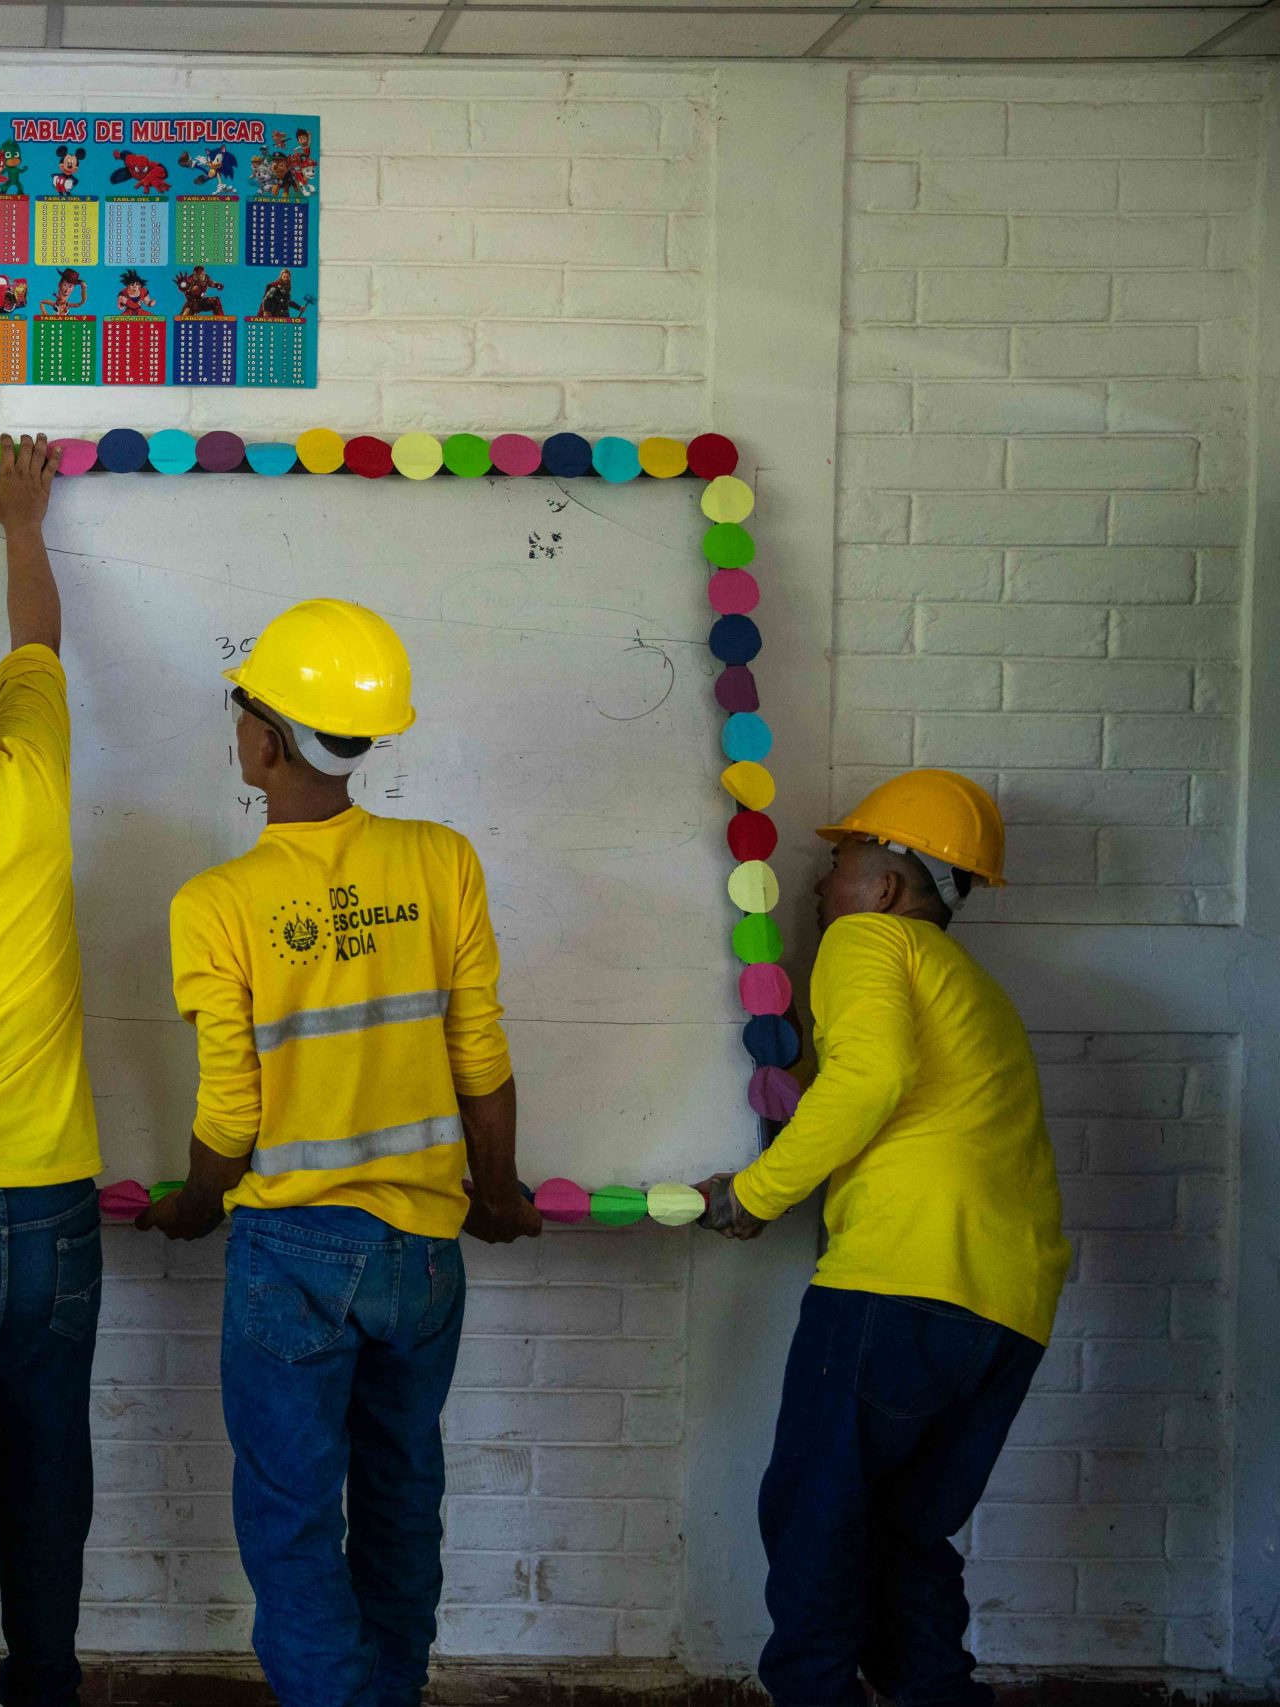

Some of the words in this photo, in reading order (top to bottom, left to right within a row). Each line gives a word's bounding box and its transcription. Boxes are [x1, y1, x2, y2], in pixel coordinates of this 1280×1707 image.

[12, 119, 86, 142] TABLAS
[95, 120, 123, 142] DE
[132, 120, 265, 143] MULTIPLICAR
[329, 884, 359, 910] DOS
[333, 903, 419, 932] ESCUELAS
